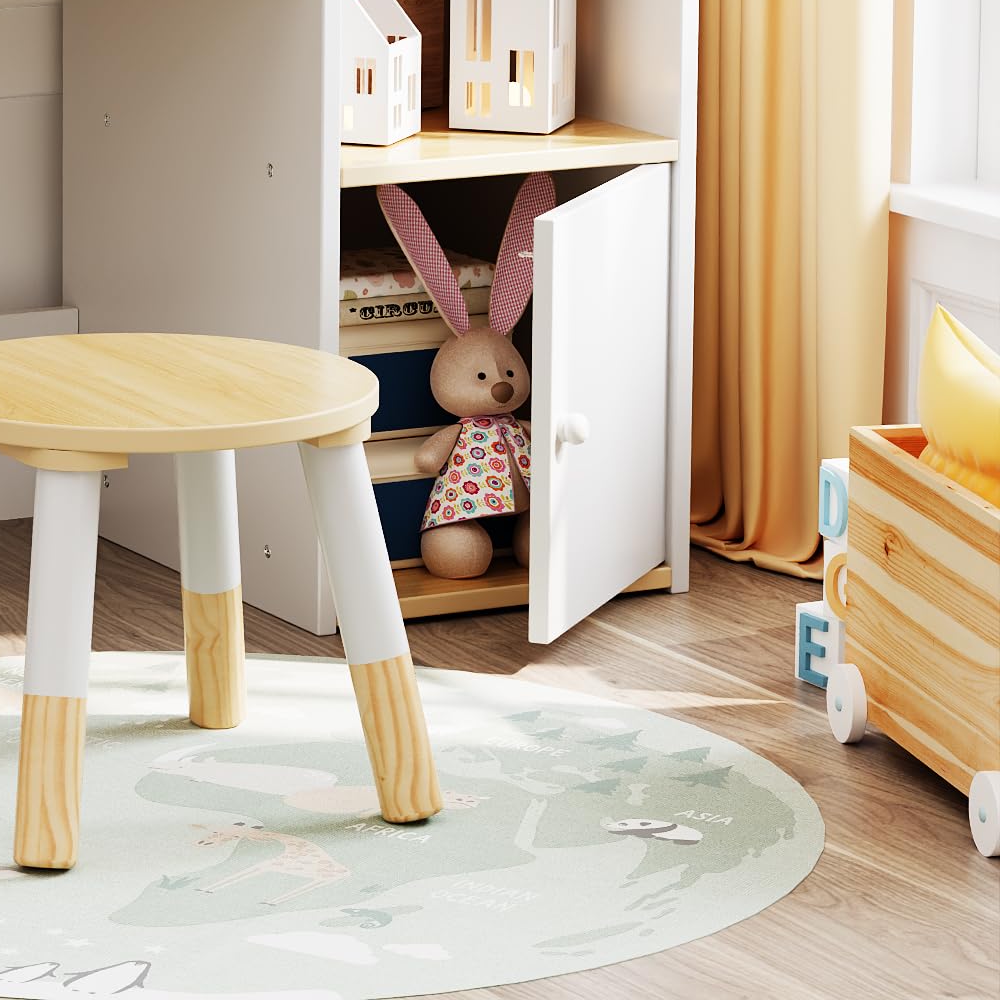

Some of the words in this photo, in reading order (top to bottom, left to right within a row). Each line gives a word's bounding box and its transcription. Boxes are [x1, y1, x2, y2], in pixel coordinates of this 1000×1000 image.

[360, 300, 439, 319] CIRCU
[819, 466, 847, 538] D
[799, 612, 829, 689] E
[488, 736, 571, 757] EUROPE
[672, 809, 734, 825] ASIA
[345, 822, 432, 844] AFRICA
[431, 889, 516, 912] OCEAN
[451, 879, 541, 901] INDIAN
